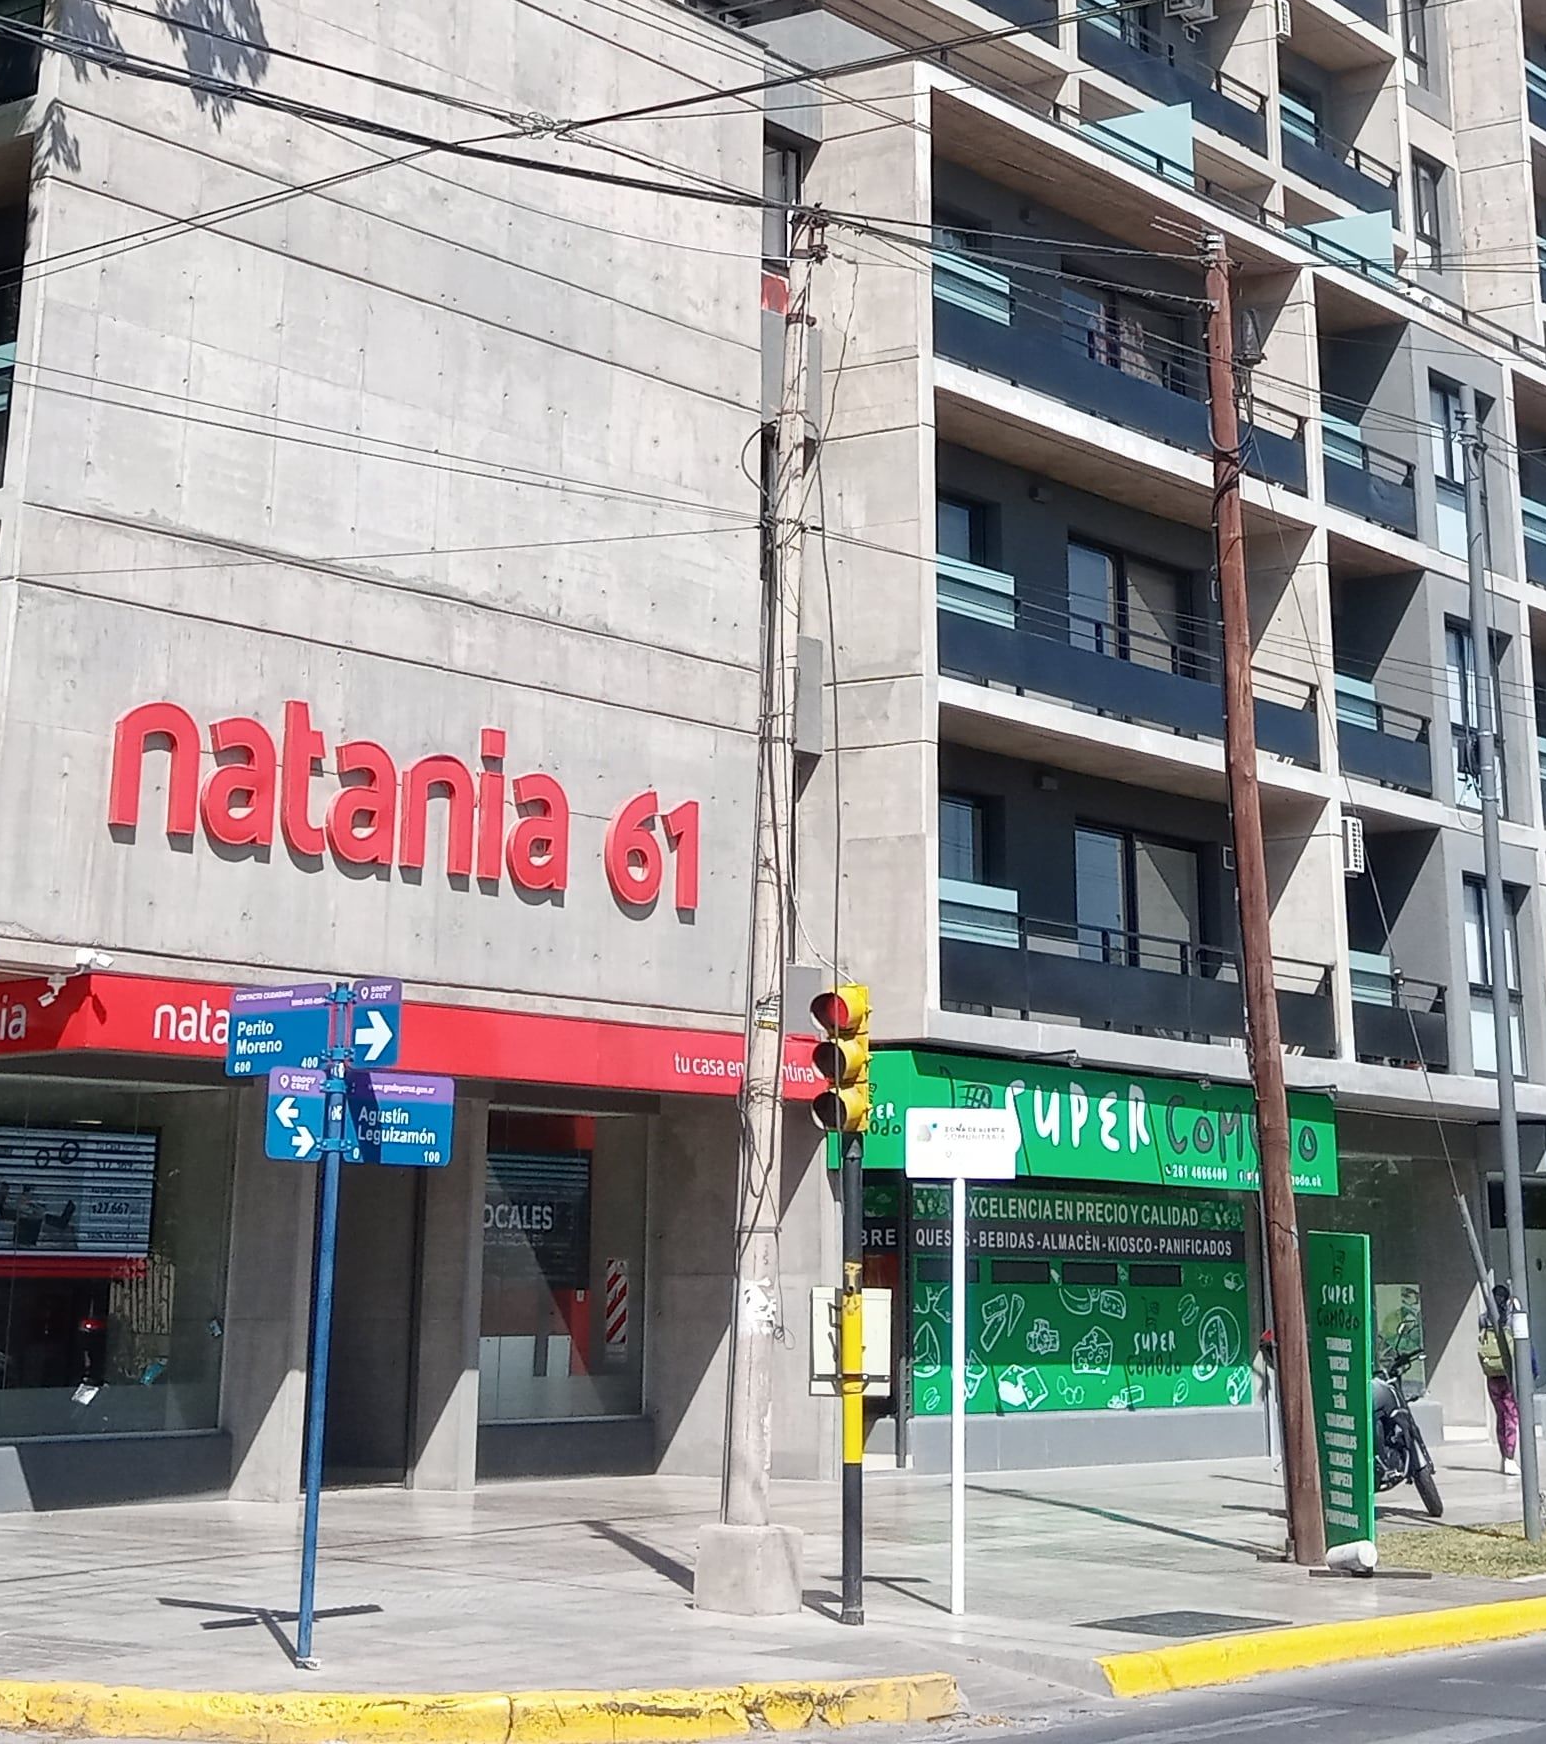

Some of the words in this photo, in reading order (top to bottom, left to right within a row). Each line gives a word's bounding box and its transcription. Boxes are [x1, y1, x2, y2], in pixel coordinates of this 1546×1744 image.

[107, 699, 570, 892] natania
[603, 789, 701, 911] 61
[153, 1000, 230, 1045] nata
[237, 1019, 274, 1037] Perito
[235, 1039, 283, 1055] Moreno
[234, 1061, 251, 1074] 600
[301, 1056, 319, 1068] 400
[673, 1052, 690, 1074] tu
[692, 1056, 725, 1076] casa
[726, 1061, 745, 1078] en
[358, 1106, 409, 1126] Agustín
[357, 1124, 436, 1145] Leguizamón
[423, 1150, 440, 1163] 100
[483, 1203, 553, 1230] OCALES
[968, 1196, 1053, 1220] XCELENCIA
[1055, 1199, 1073, 1221] EN
[1076, 1201, 1128, 1224] PRECIO
[1128, 1204, 1139, 1224] Y
[1141, 1204, 1199, 1227] CALIDAD
[861, 1228, 897, 1246] BRE
[916, 1228, 971, 1247] QUESS
[979, 1231, 1035, 1249] BEBIDAS
[1107, 1235, 1153, 1254] KIOSCO
[1159, 1237, 1233, 1256] PANIFICADOS
[1321, 1284, 1355, 1305] SUPER
[1133, 1330, 1176, 1355] SUPER
